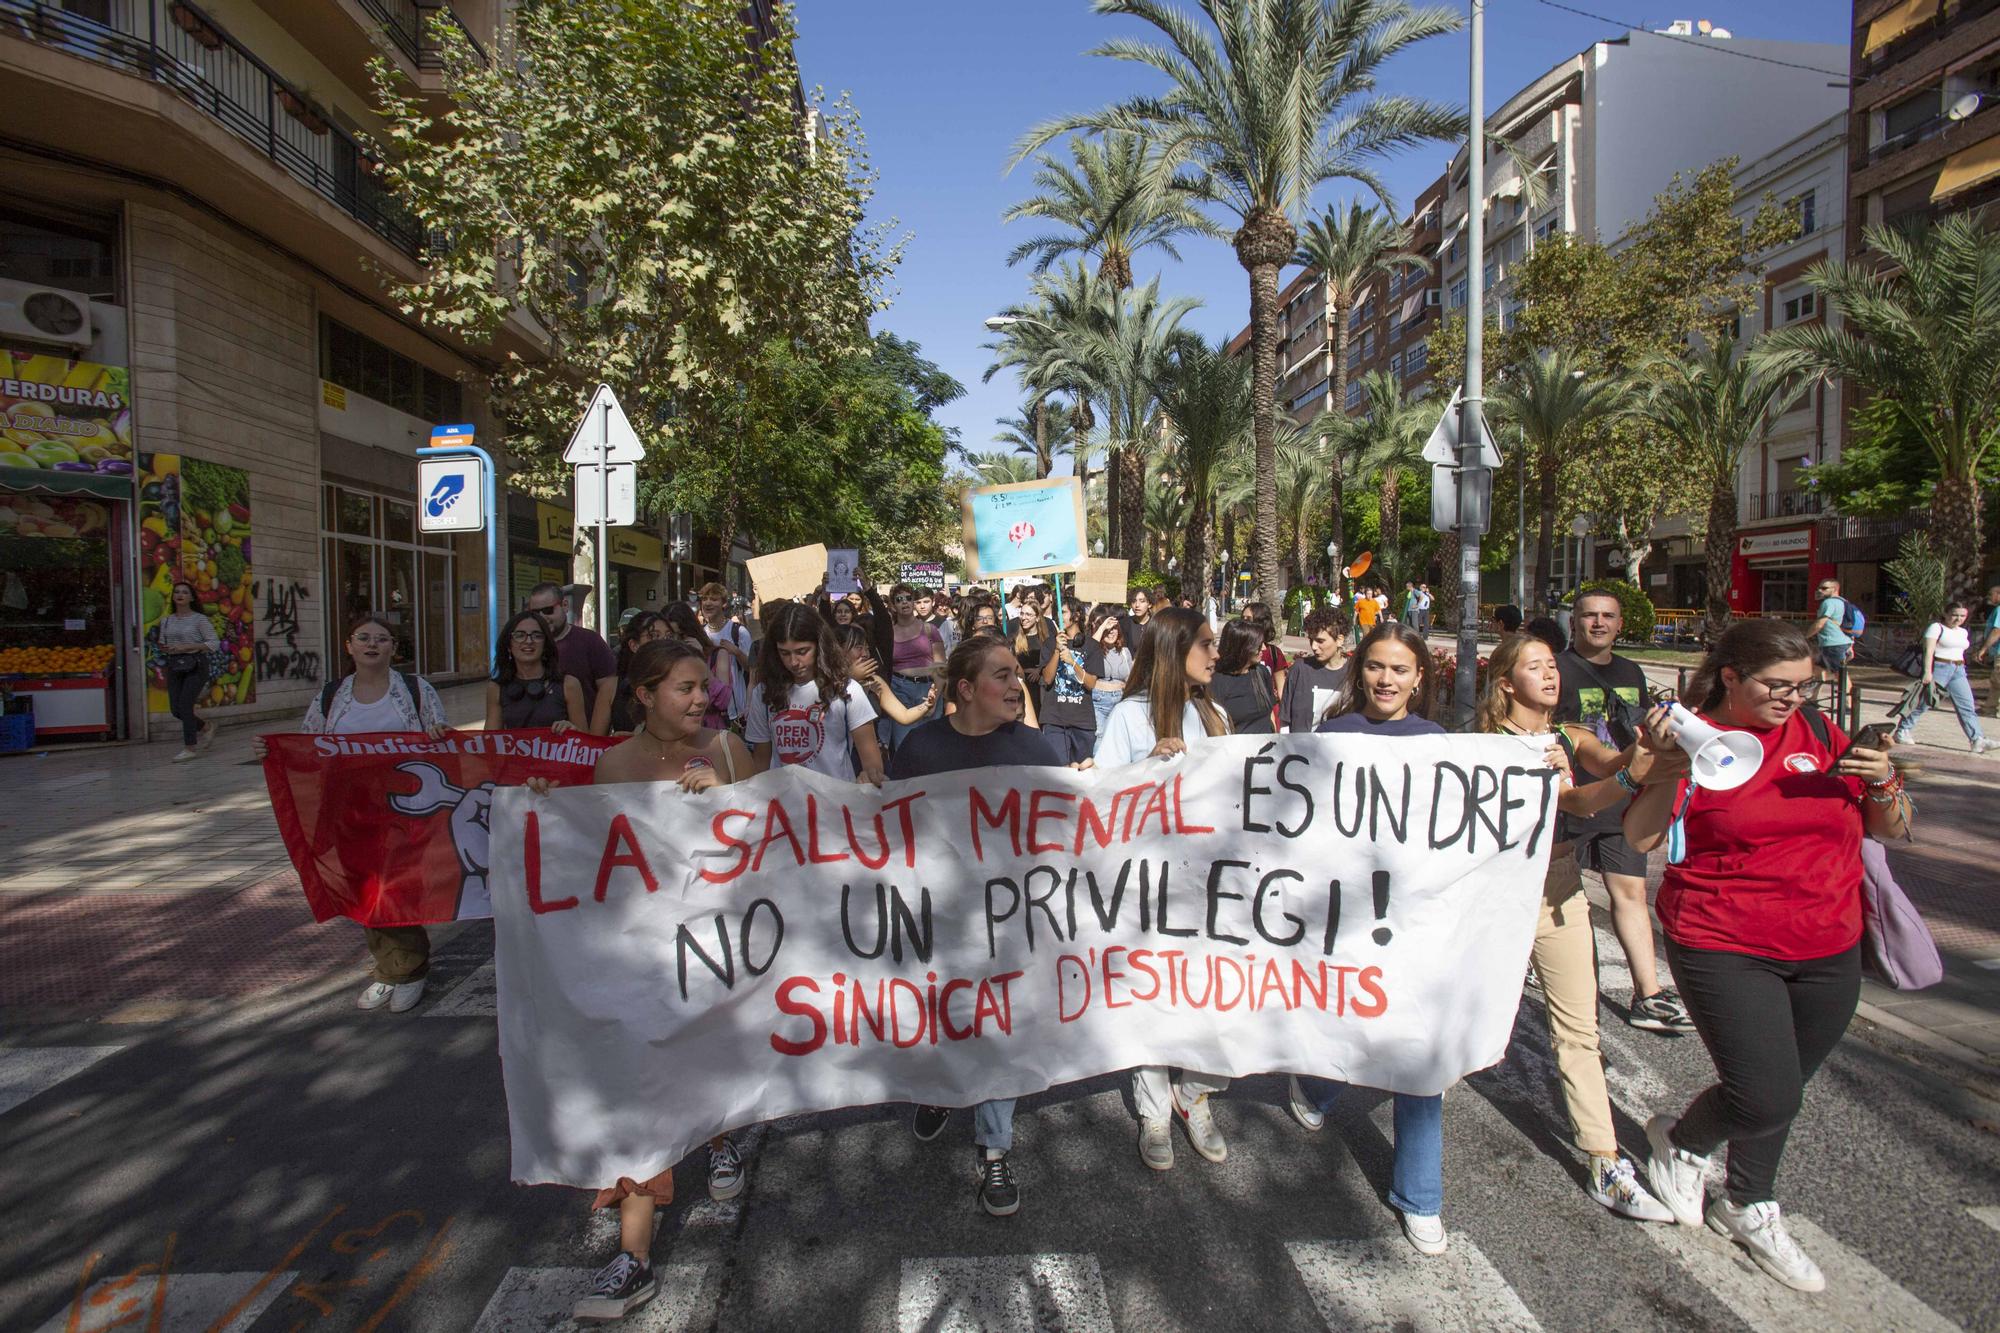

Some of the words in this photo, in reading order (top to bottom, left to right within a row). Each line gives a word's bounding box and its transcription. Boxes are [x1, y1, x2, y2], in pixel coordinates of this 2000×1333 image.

[13, 415, 98, 437] DIARIO
[776, 725, 810, 737] OPEN
[314, 736, 456, 758] Sindicat
[776, 737, 810, 748] ARMS
[523, 809, 660, 915] LA
[699, 790, 926, 884] SALUT
[968, 772, 1216, 861] MENTAL
[1241, 742, 1315, 839] ÉS
[1333, 761, 1412, 844] UN
[1428, 760, 1562, 859] DRET
[675, 896, 786, 1003] NO
[838, 882, 934, 965] UN
